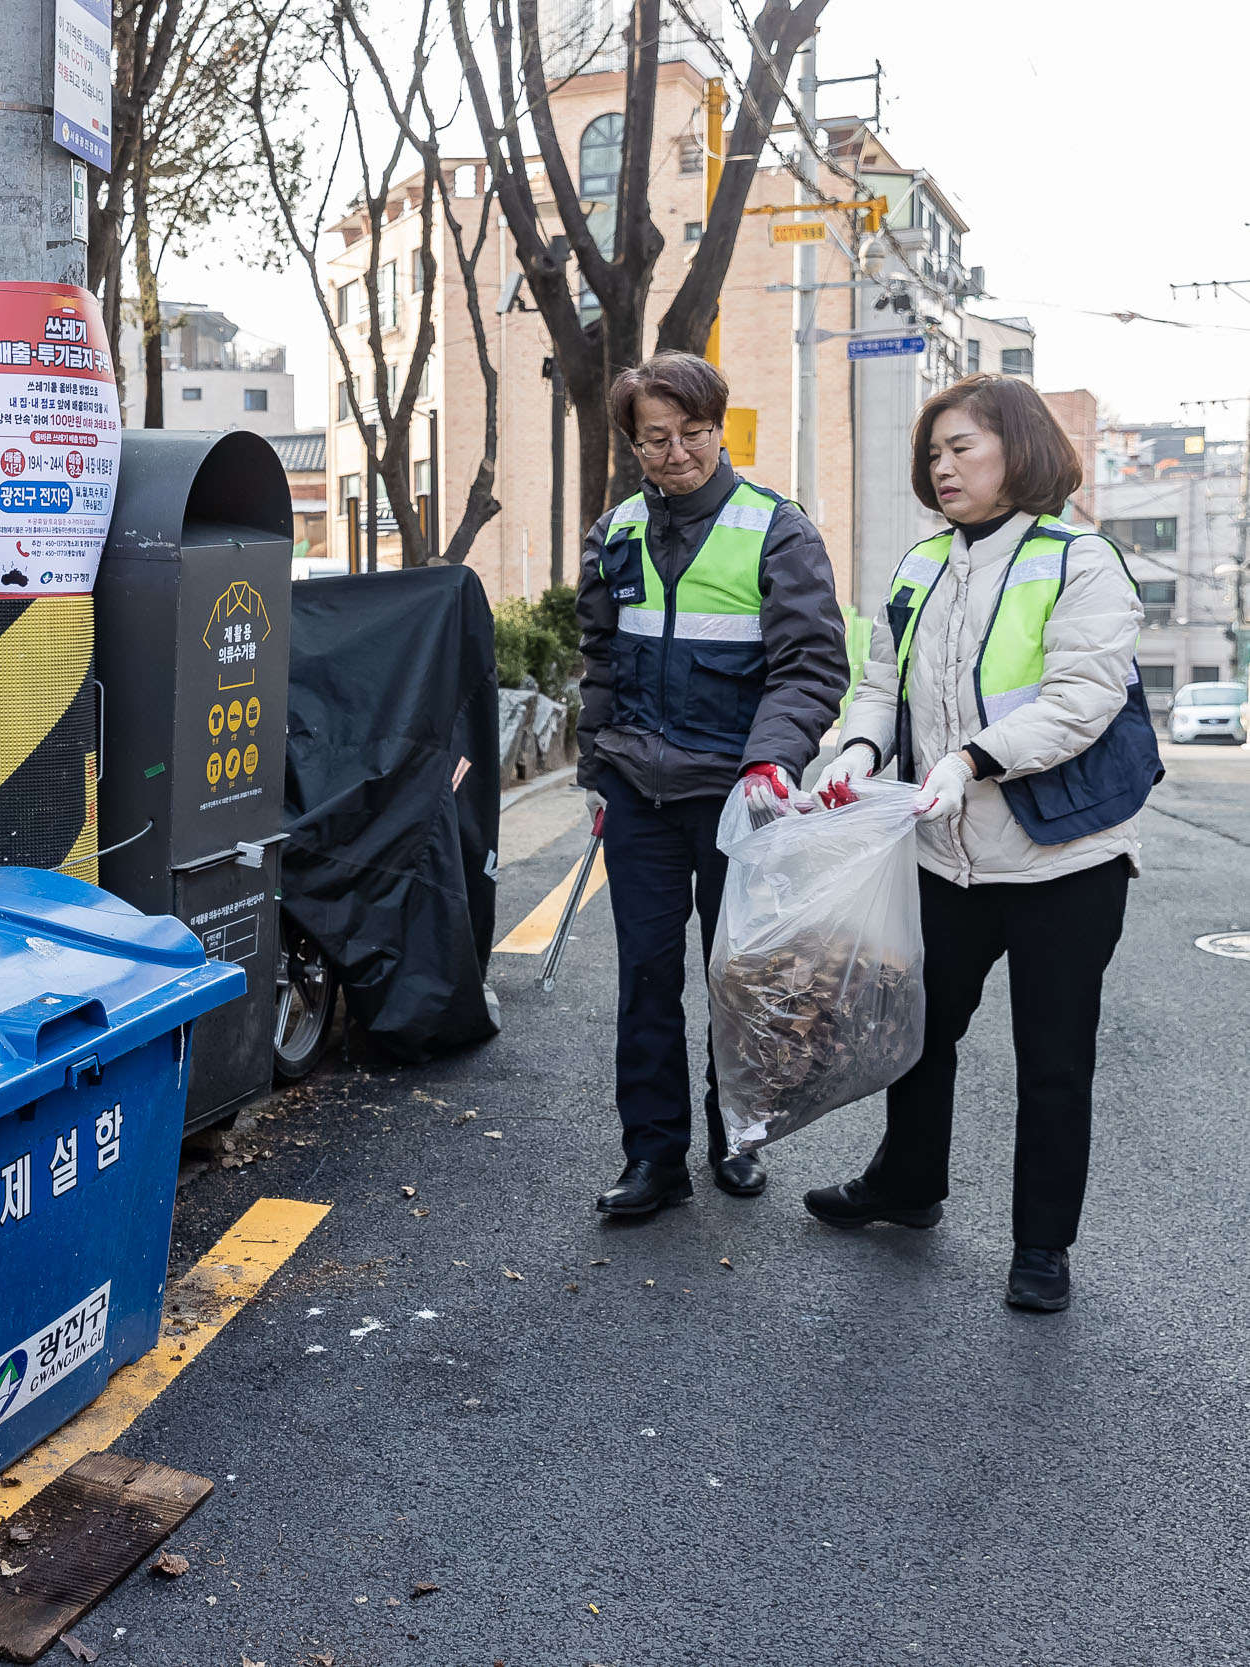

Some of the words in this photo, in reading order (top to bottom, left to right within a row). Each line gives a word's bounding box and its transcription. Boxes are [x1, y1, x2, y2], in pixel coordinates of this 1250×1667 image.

[58, 15, 65, 33] 이
[66, 20, 83, 46] 지역은
[83, 33, 110, 67] 범죄예방을
[58, 38, 70, 60] 위해
[71, 48, 93, 76] CCTV가
[58, 61, 81, 89] 작동되고
[45, 316, 88, 344] 쓰레기
[27, 381, 58, 393] 쓰레기를
[59, 382, 78, 395] 올바른
[78, 384, 99, 397] 방법으로
[9, 396, 17, 408] 내
[40, 397, 56, 410] 점포
[56, 398, 71, 410] 앞에
[71, 400, 93, 413] 배출하지
[50, 413, 82, 428] 100만원
[82, 418, 93, 429] 이하
[93, 418, 108, 430] 과태료
[53, 432, 69, 443] 쓰레기
[4, 451, 22, 464] 배출
[28, 454, 43, 472] 19시
[50, 454, 64, 473] 24시
[68, 453, 82, 465] 배출
[4, 464, 22, 475] 시간
[68, 464, 82, 476] 장소
[0, 486, 37, 508] 광진구
[39, 486, 71, 508] 전지역
[31, 540, 42, 548] 주간
[54, 572, 90, 583] 광진구청장
[223, 622, 253, 645] 재활용
[217, 641, 257, 665] 의류수거함
[36, 1292, 108, 1369] 광진구
[30, 1326, 106, 1394] GWANGJIN-GU
